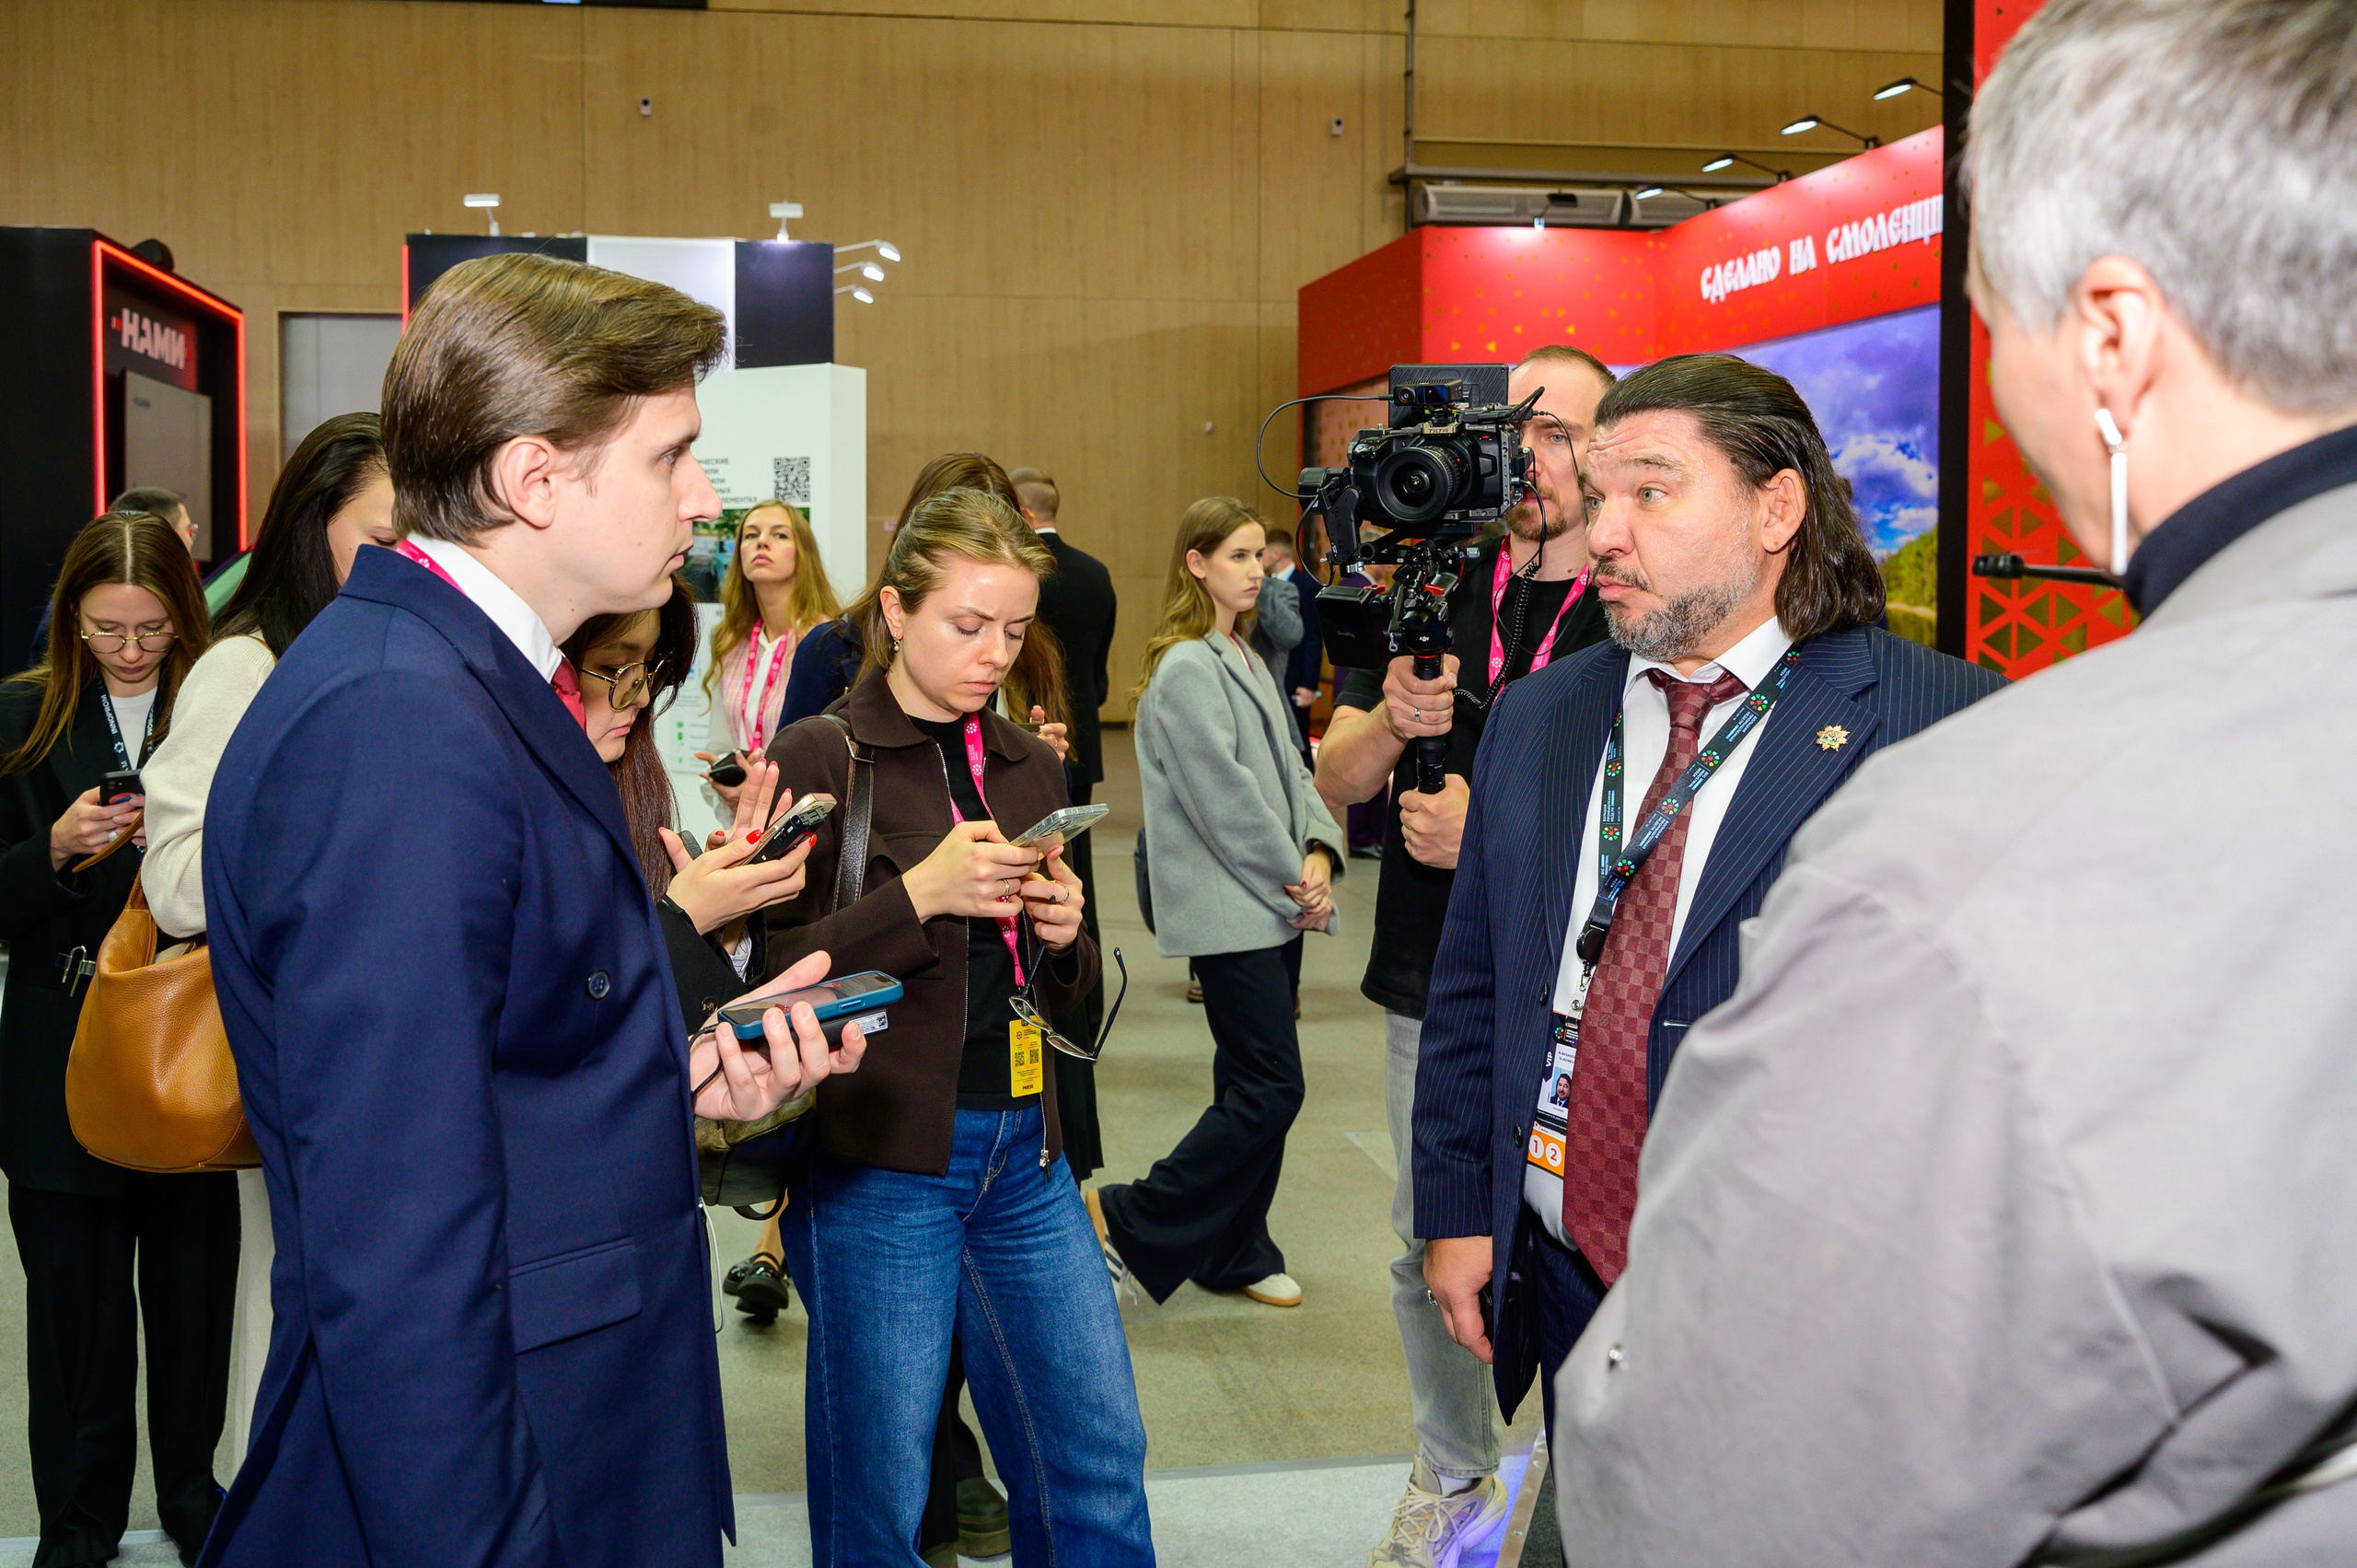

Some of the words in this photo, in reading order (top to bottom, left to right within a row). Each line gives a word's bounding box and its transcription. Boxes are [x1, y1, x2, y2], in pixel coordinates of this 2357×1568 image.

[1701, 245, 1781, 305] СДЕЛАНО
[1789, 235, 1817, 275] НА
[121, 307, 186, 370] НАМИ
[100, 693, 118, 735] INNOPROM
[1545, 1051, 1553, 1067] VIP
[1533, 1139, 1538, 1154] 1
[1550, 1147, 1558, 1162] 2
